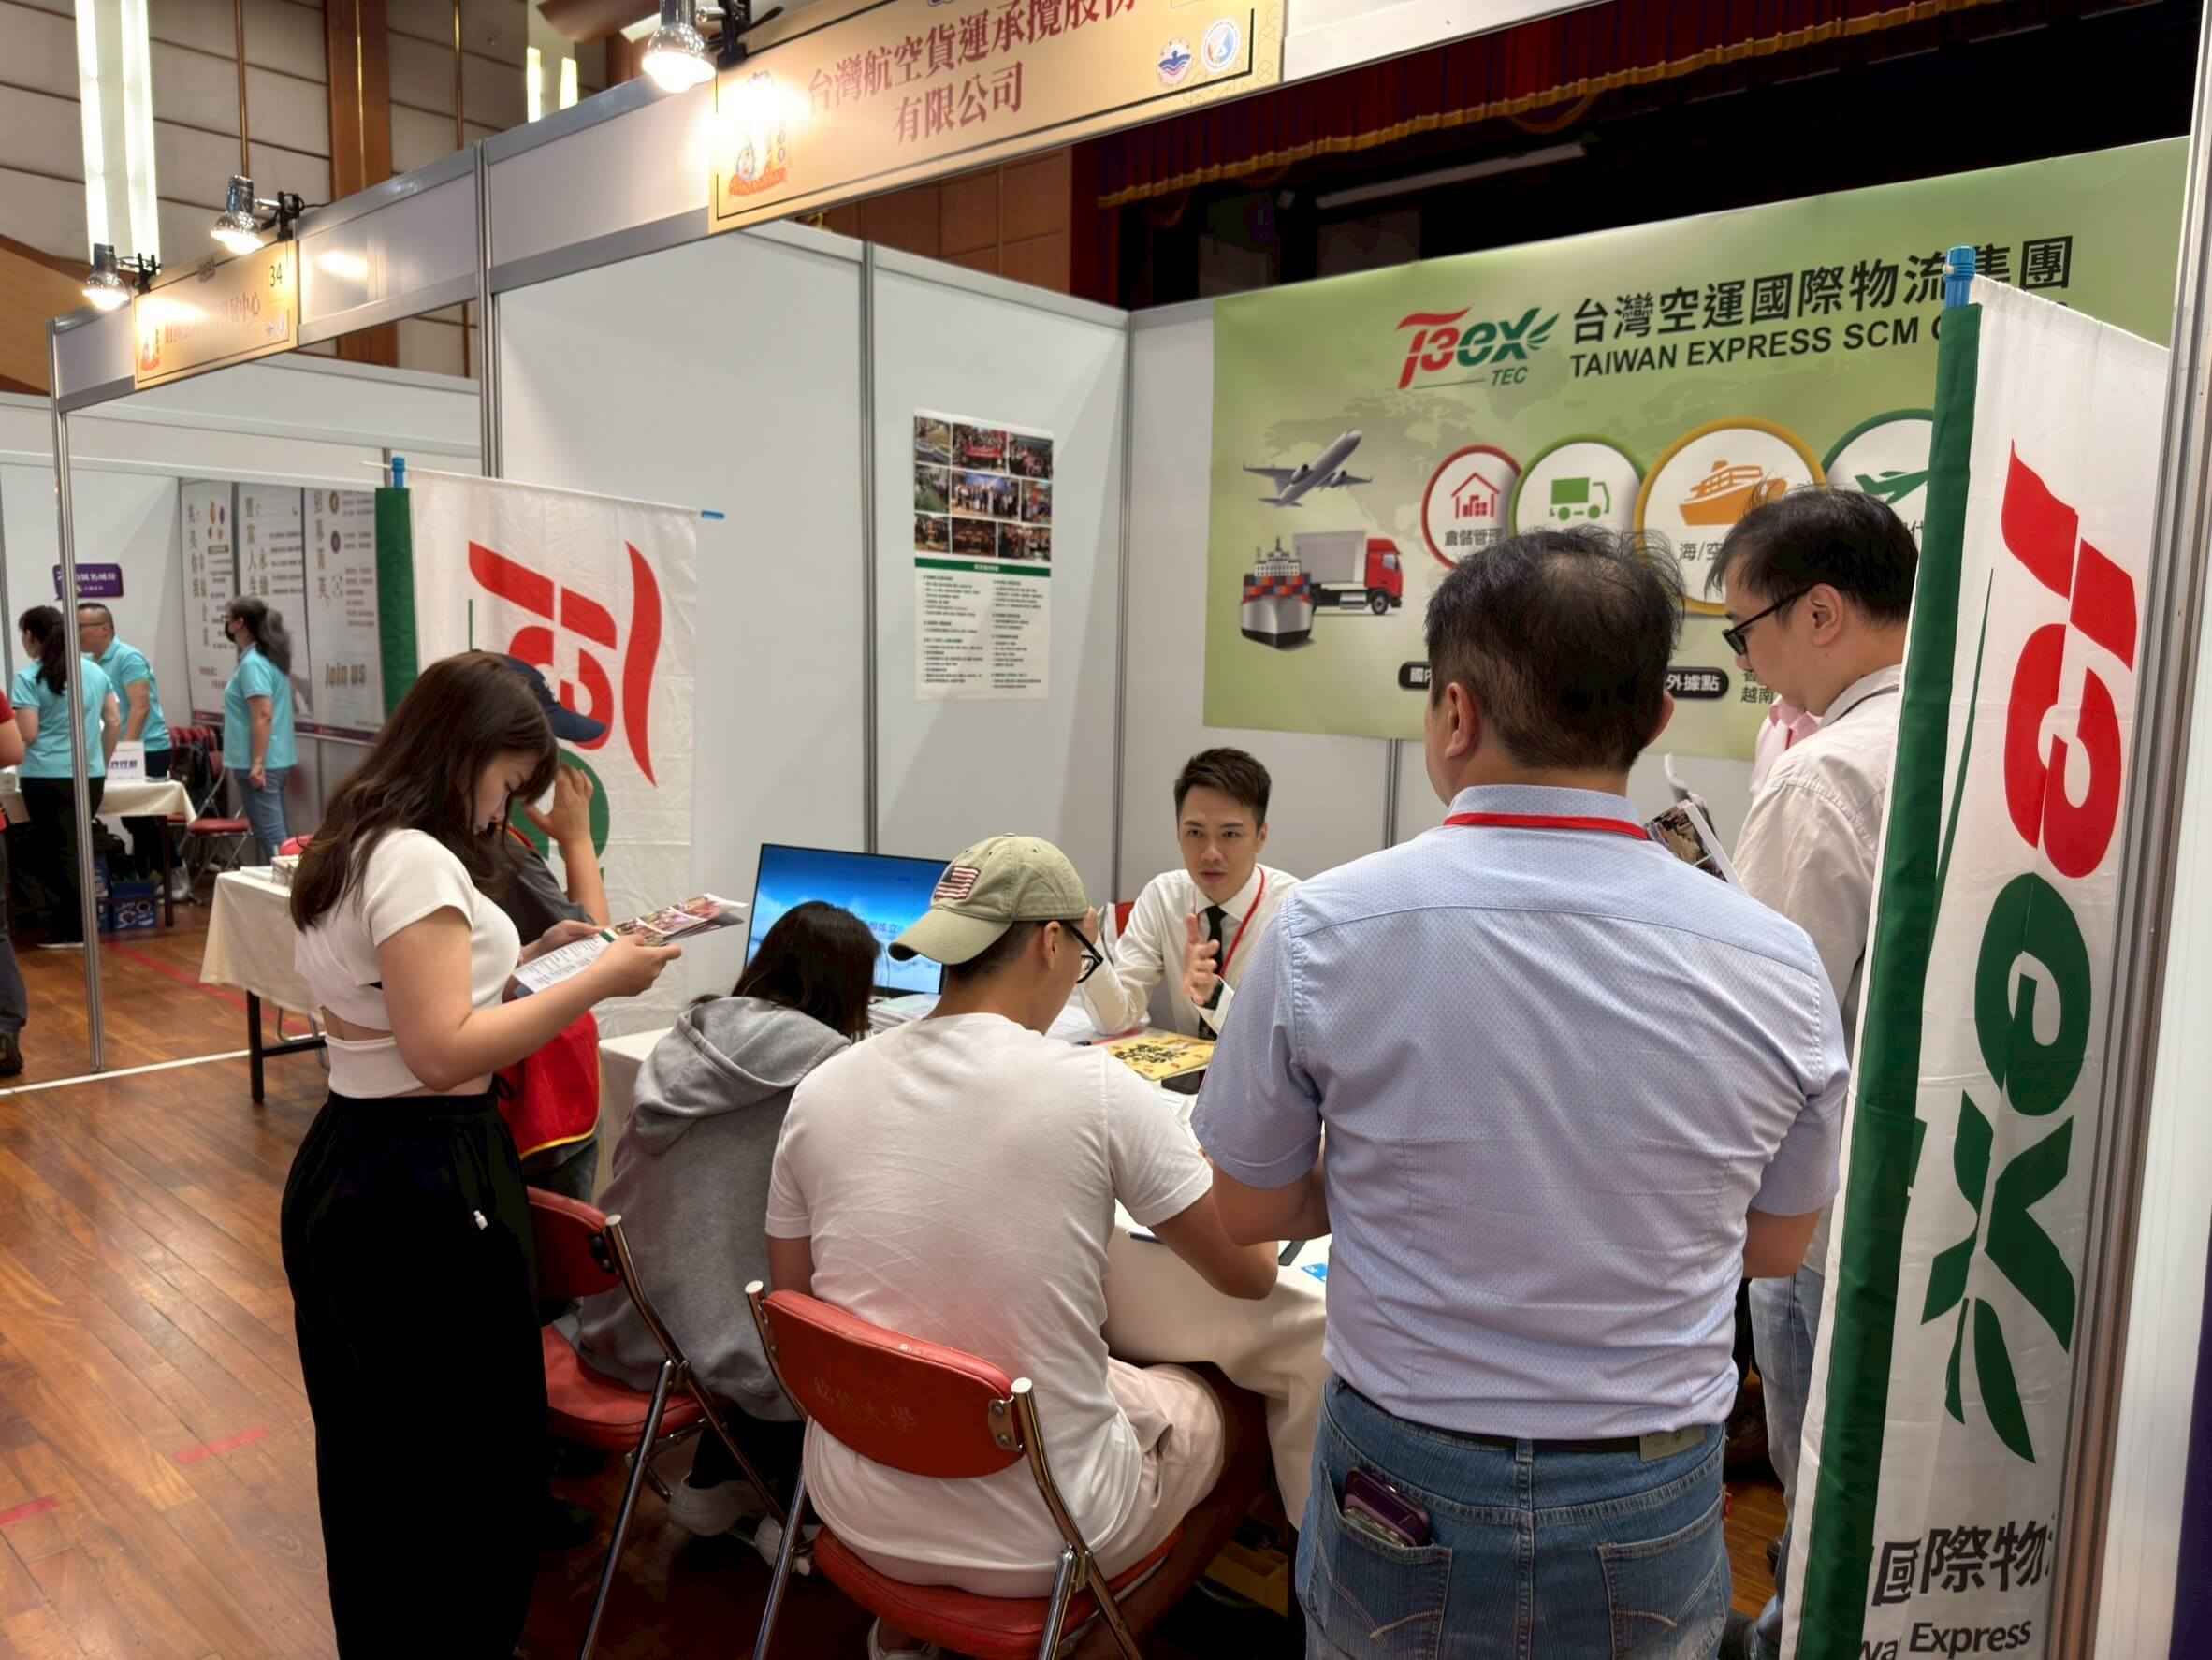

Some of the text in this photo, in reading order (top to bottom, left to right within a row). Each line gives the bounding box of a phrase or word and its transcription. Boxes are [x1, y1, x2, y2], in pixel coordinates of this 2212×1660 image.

[894, 60, 1024, 145] 有限公司
[269, 262, 283, 287] 34
[1570, 343, 1677, 378] TAIWAN
[1687, 326, 1831, 366] EXPRESS
[1843, 316, 1918, 351] SCM
[1492, 366, 1528, 387] TEC
[1872, 1512, 2056, 1607] 國際物
[1909, 1620, 2032, 1660] Express
